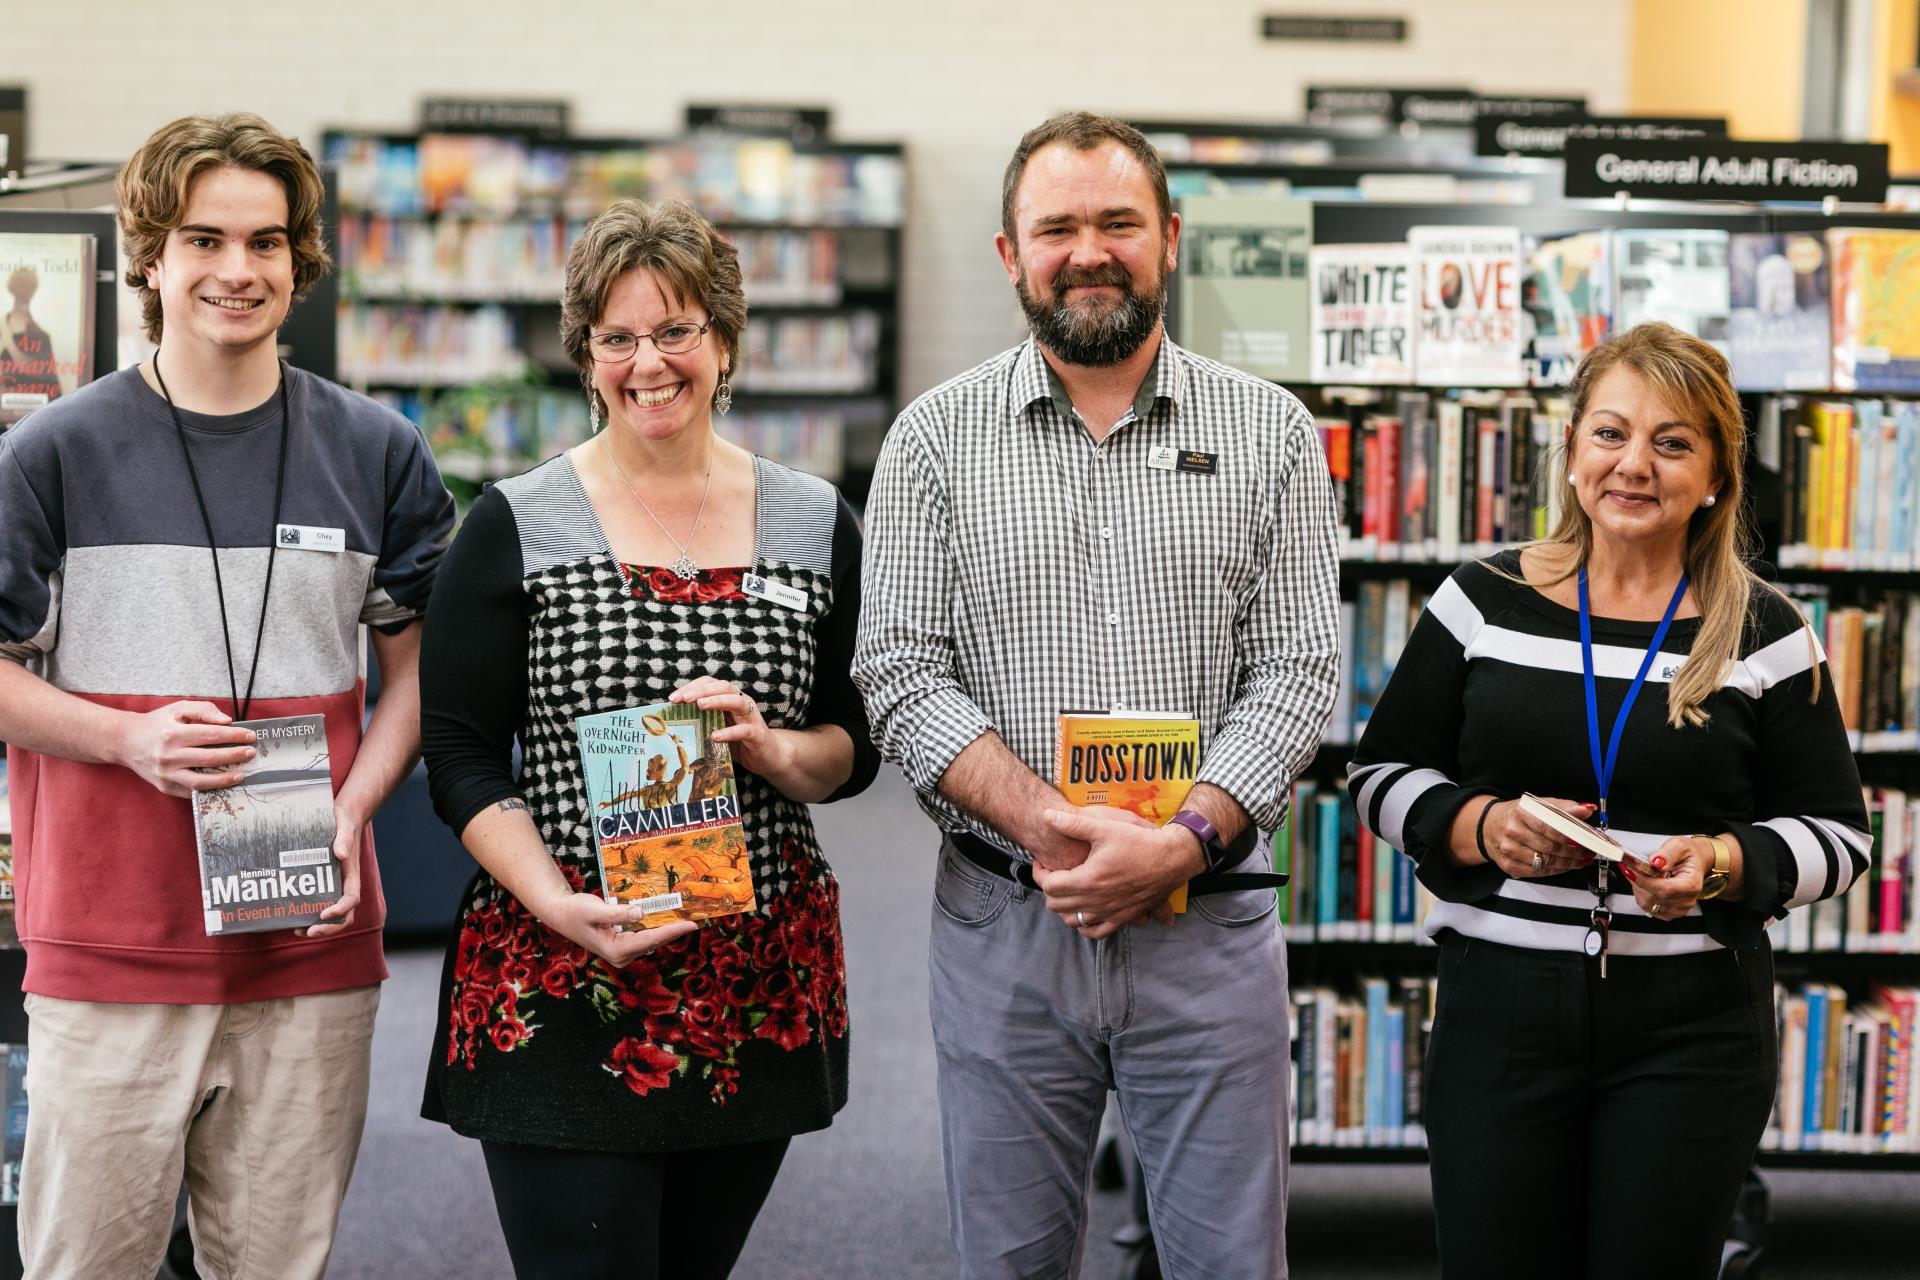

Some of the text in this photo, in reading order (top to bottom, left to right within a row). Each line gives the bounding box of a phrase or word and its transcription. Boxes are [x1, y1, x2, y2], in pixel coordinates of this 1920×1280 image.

[1595, 153, 1858, 187] General Adult Fiction
[0, 256, 79, 273] arles Todd
[1420, 261, 1513, 310] LOVE
[17, 335, 42, 352] An
[1320, 326, 1408, 367] TIGER
[775, 590, 802, 602] Jennifer
[610, 715, 634, 728] THE
[271, 723, 316, 739] MYSTERY
[584, 727, 648, 743] OVERNIGHT
[587, 740, 646, 755] KIDNAPPER
[1070, 741, 1195, 784] BOSSTOWN
[598, 794, 740, 839] CAMILLERI
[240, 868, 277, 879] Henning
[211, 865, 335, 905] Mankell
[237, 905, 272, 921] Event
[274, 904, 286, 917] in
